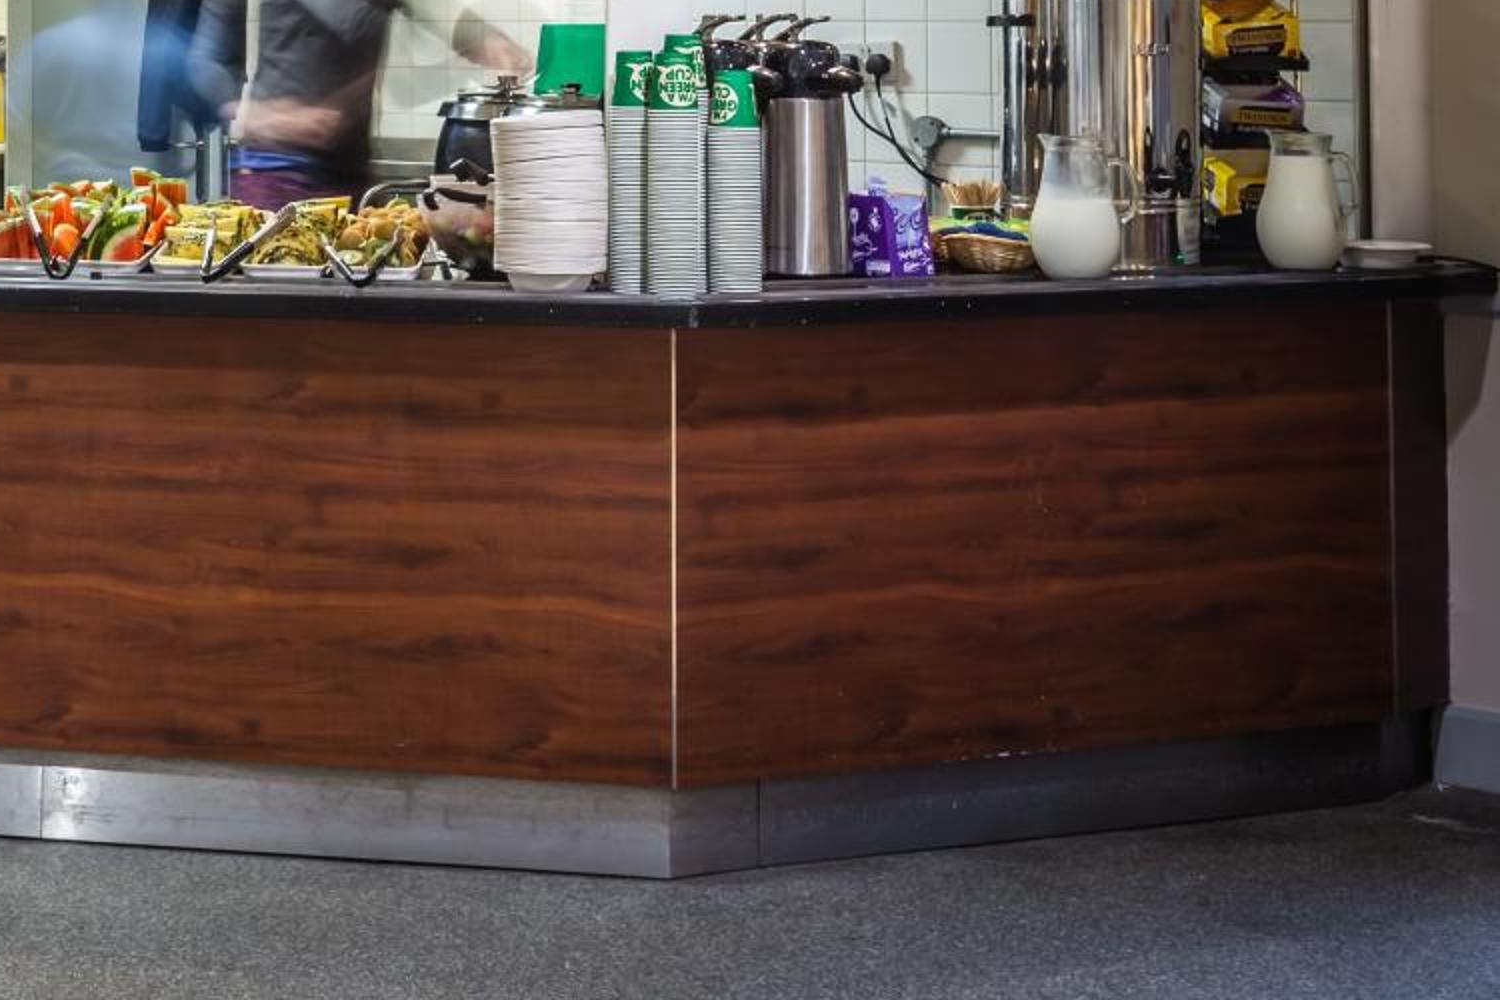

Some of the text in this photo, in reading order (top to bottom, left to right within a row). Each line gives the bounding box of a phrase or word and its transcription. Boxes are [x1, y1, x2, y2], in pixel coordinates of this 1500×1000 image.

[666, 69, 693, 81] CUP
[668, 94, 675, 103] A
[713, 87, 731, 99] CU
[713, 100, 737, 111] GRE
